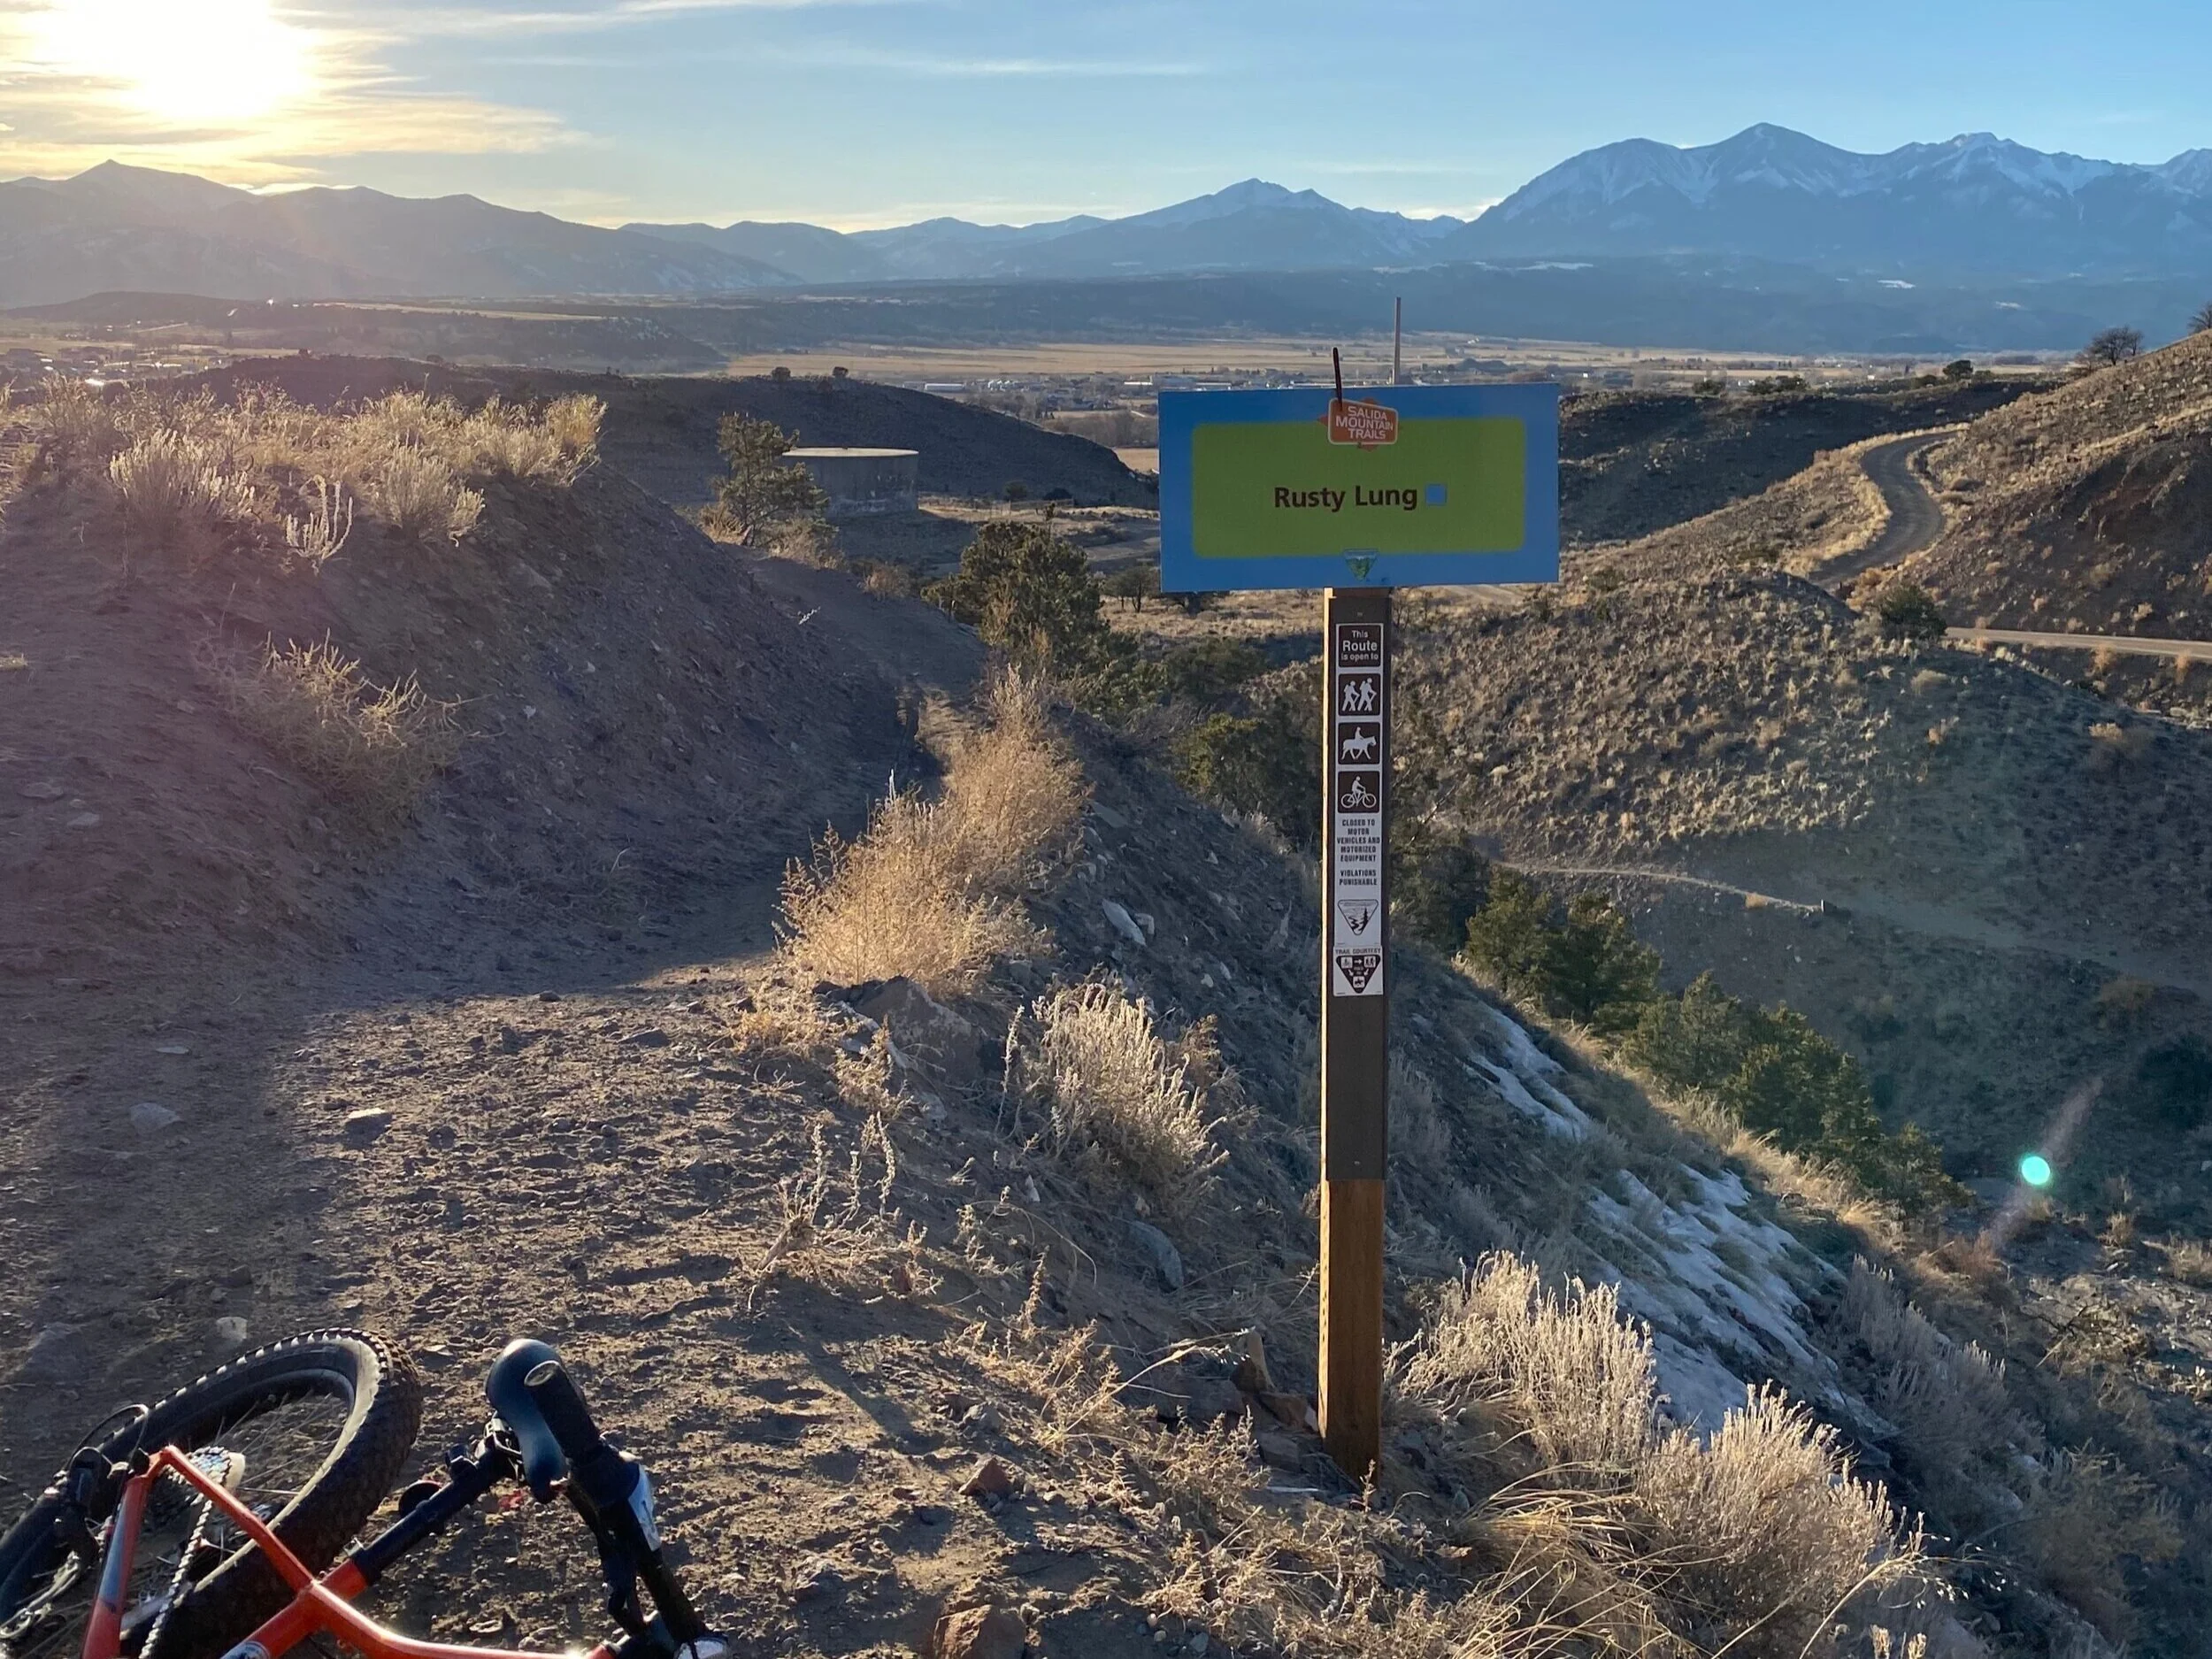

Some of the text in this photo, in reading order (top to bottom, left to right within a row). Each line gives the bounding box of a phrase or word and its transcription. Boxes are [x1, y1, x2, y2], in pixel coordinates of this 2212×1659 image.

[1348, 405, 1387, 420] SALIDA
[1335, 415, 1394, 431] MOUNTAIN
[1348, 428, 1386, 440] TRAILS
[1274, 485, 1418, 512] Rusty Lung
[1342, 640, 1378, 652] Route
[1349, 653, 1370, 662] open
